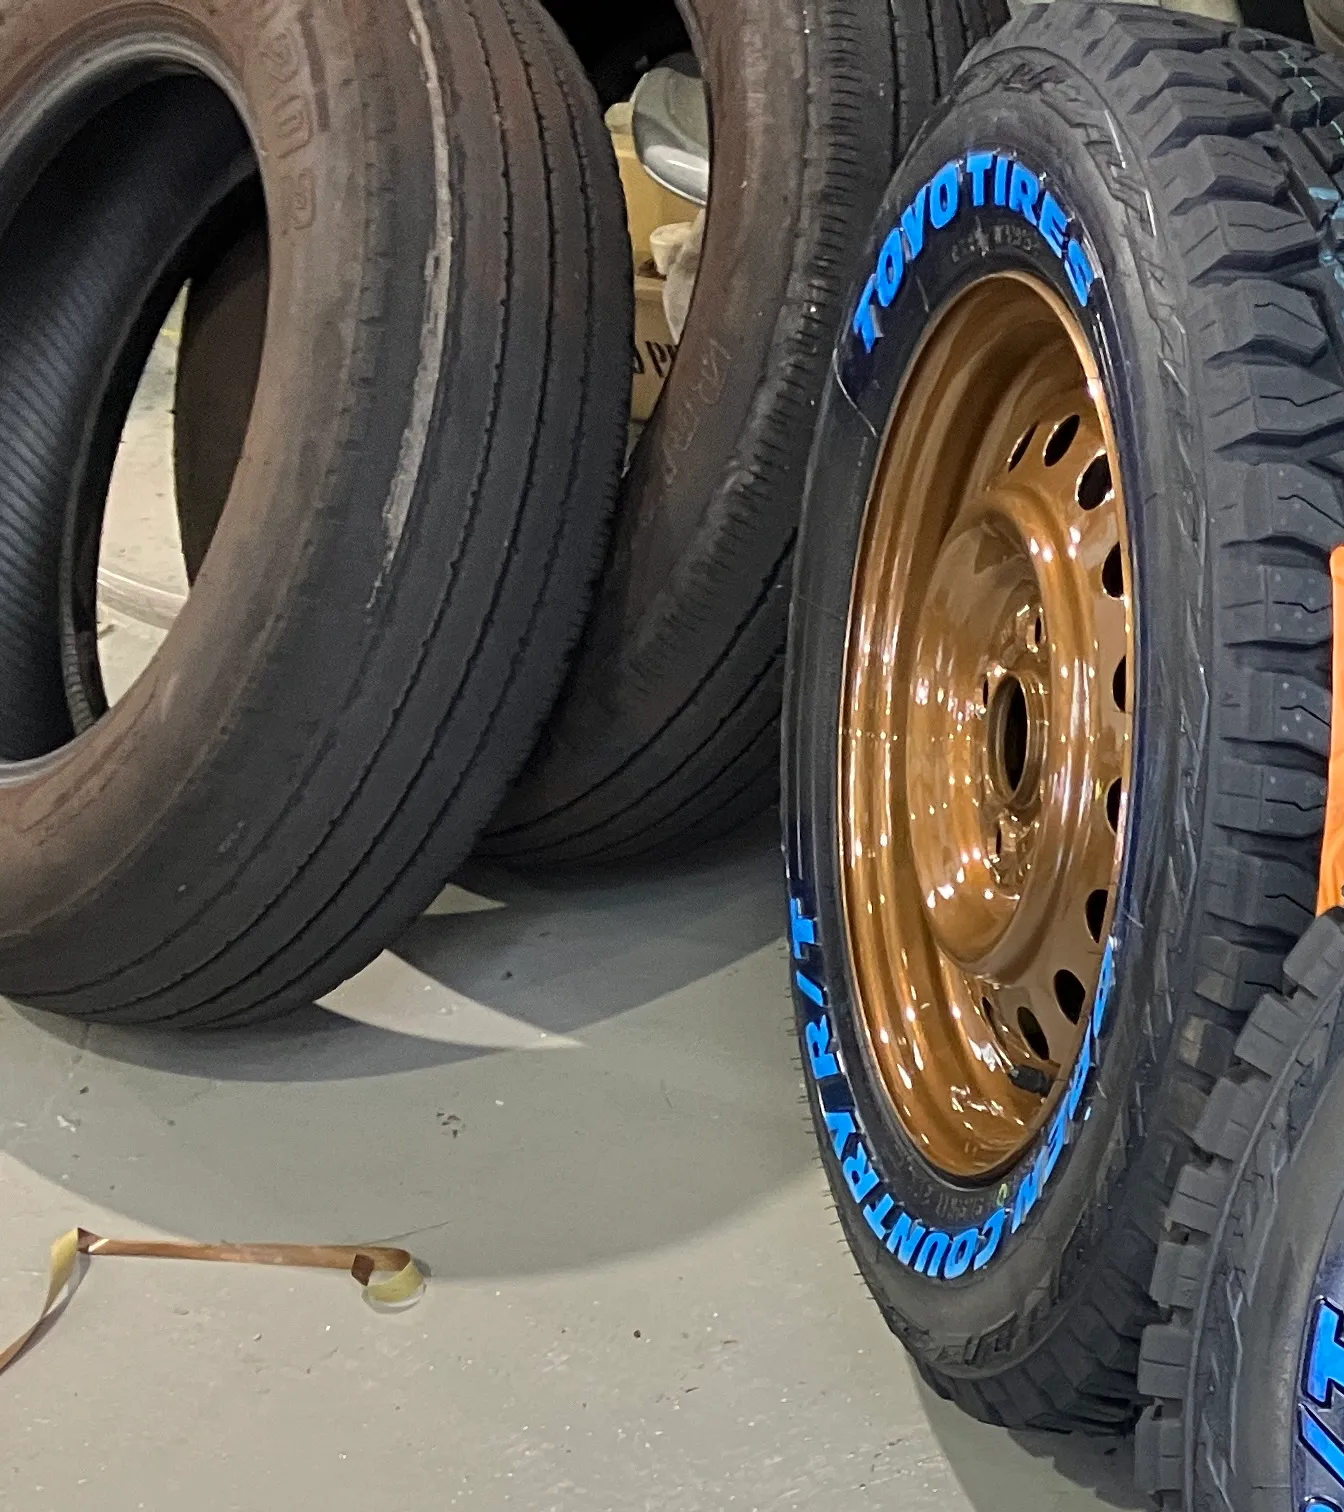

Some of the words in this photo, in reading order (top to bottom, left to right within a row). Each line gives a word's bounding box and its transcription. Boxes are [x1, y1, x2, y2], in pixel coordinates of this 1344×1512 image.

[850, 162, 962, 351] TOYO
[964, 150, 1097, 306] TIRES
[787, 896, 842, 1082] R/T
[823, 1108, 1009, 1278] COUNTRY
